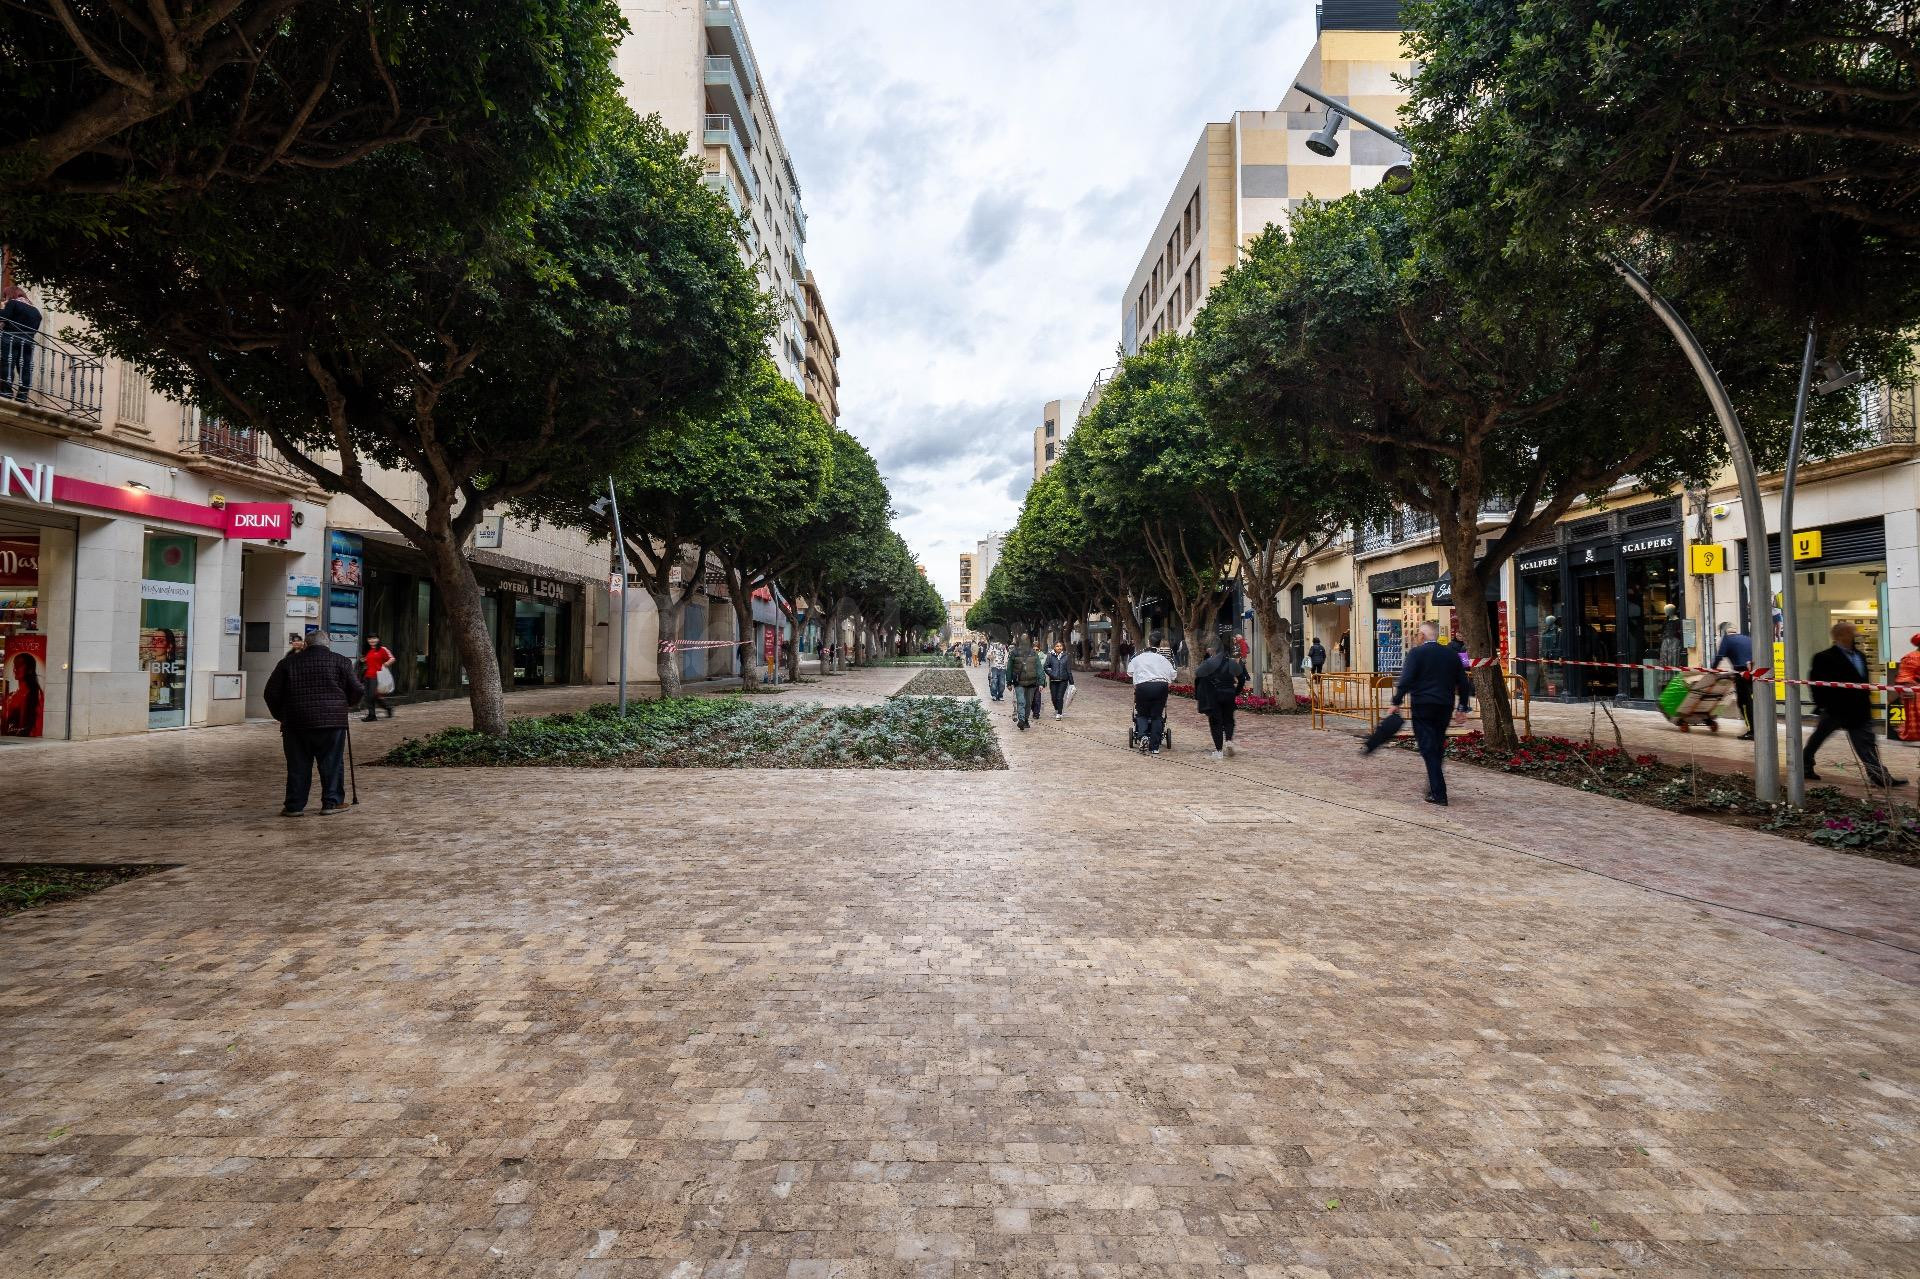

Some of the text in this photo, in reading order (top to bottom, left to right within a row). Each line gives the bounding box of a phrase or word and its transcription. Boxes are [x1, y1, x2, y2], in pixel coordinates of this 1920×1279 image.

[235, 514, 280, 527] DRUNI
[1622, 537, 1673, 553] SCALPERS
[1520, 557, 1558, 571] SCALPERS
[533, 578, 564, 600] LEON
